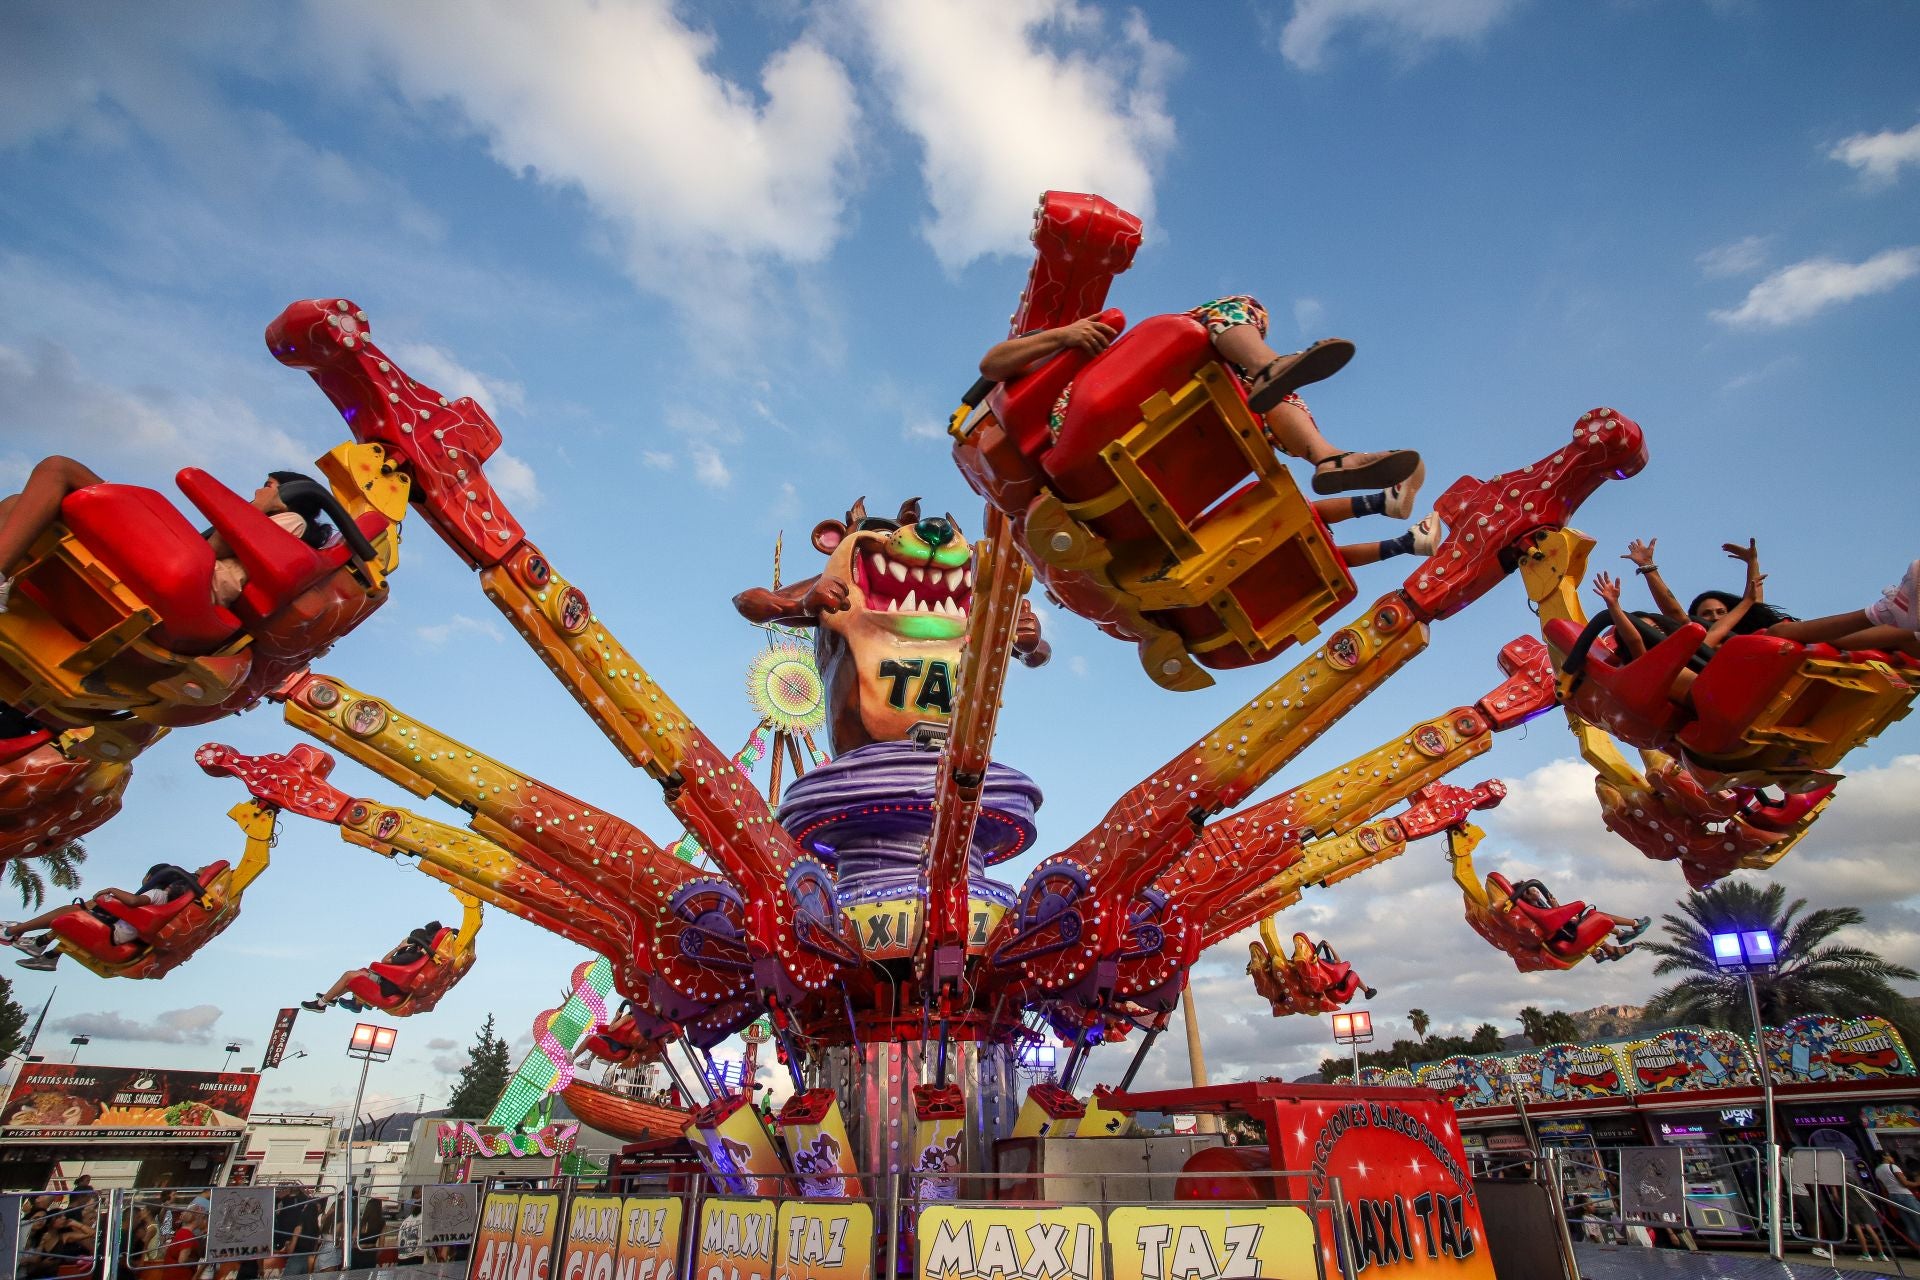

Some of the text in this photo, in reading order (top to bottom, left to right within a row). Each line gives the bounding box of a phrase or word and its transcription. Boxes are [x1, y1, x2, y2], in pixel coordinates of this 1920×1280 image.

[314, 685, 334, 702] 10
[879, 658, 959, 714] TA
[1831, 1021, 1872, 1042] PRUEBA
[1852, 1035, 1894, 1052] SUERTE
[1634, 1056, 1676, 1070] HABILIDAD
[26, 1075, 96, 1087] PATATAS ASADAS
[199, 1082, 247, 1093] DONER KEBAB
[1720, 1108, 1753, 1121] LUCKY
[1735, 1117, 1746, 1127] 7
[1105, 1117, 1121, 1133] 2
[1369, 1103, 1420, 1140] BLASCO
[1420, 1122, 1474, 1207] SANCHEZ
[483, 1199, 550, 1237] MAXI TAZ
[570, 1205, 668, 1248] MAXI TAZ
[1413, 1191, 1475, 1259] TAZ
[702, 1209, 850, 1268] MAXI TAZ
[925, 1219, 1265, 1280] MAXI TAZ
